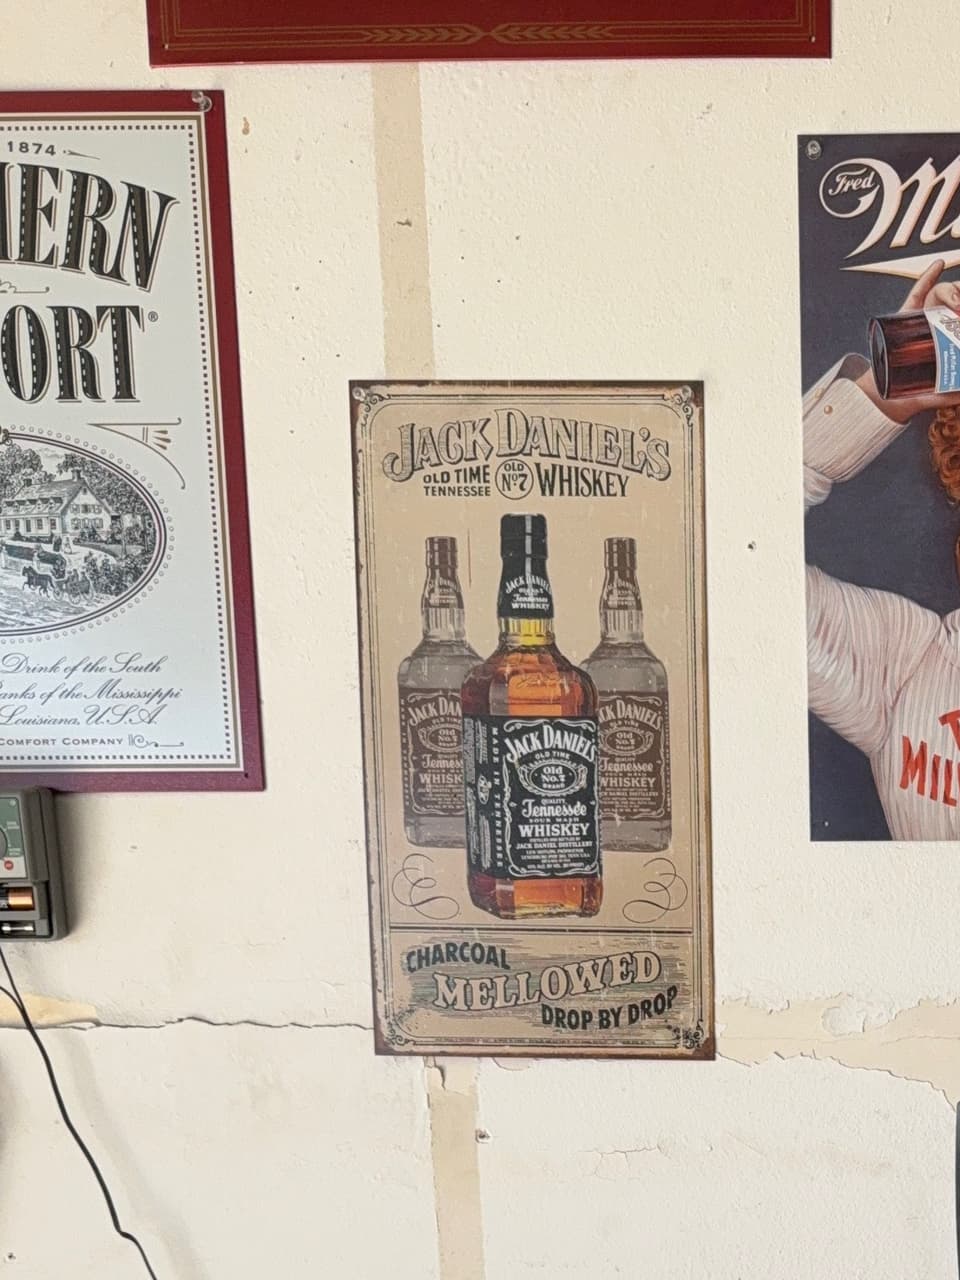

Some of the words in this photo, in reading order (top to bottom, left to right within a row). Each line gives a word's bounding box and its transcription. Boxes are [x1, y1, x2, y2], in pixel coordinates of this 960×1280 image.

[8, 141, 57, 156] 1874
[828, 168, 875, 195] Fred
[383, 418, 494, 482] JACK
[494, 408, 672, 482] DANIEL'S
[423, 470, 451, 484] OLD
[454, 464, 491, 484] TIME
[504, 462, 525, 472] OLD
[535, 462, 630, 497] WHISKEY
[423, 486, 491, 497] TENNESSEE
[0, 653, 66, 674] Drink
[64, 656, 91, 680] of
[82, 656, 108, 673] the
[109, 652, 169, 674] South
[0, 680, 38, 699] anks
[40, 682, 66, 706] of
[58, 682, 84, 699] the
[84, 678, 183, 705] Mississippi
[408, 701, 438, 726] JACK
[62, 737, 124, 746] COMPANY
[492, 727, 500, 763] MADE
[504, 731, 543, 763] JACK
[543, 724, 598, 763] DANIEL'S
[534, 751, 551, 760] OLD
[552, 751, 571, 760] TIME
[543, 765, 564, 775] Old
[521, 799, 588, 818] Tennessee
[518, 823, 590, 838] WHISKEY
[406, 942, 511, 973] CHARCOAL
[431, 950, 662, 1012] MELLOWED
[541, 1003, 594, 1030] DROP
[600, 1006, 623, 1029] BY
[628, 985, 679, 1025] DROP
